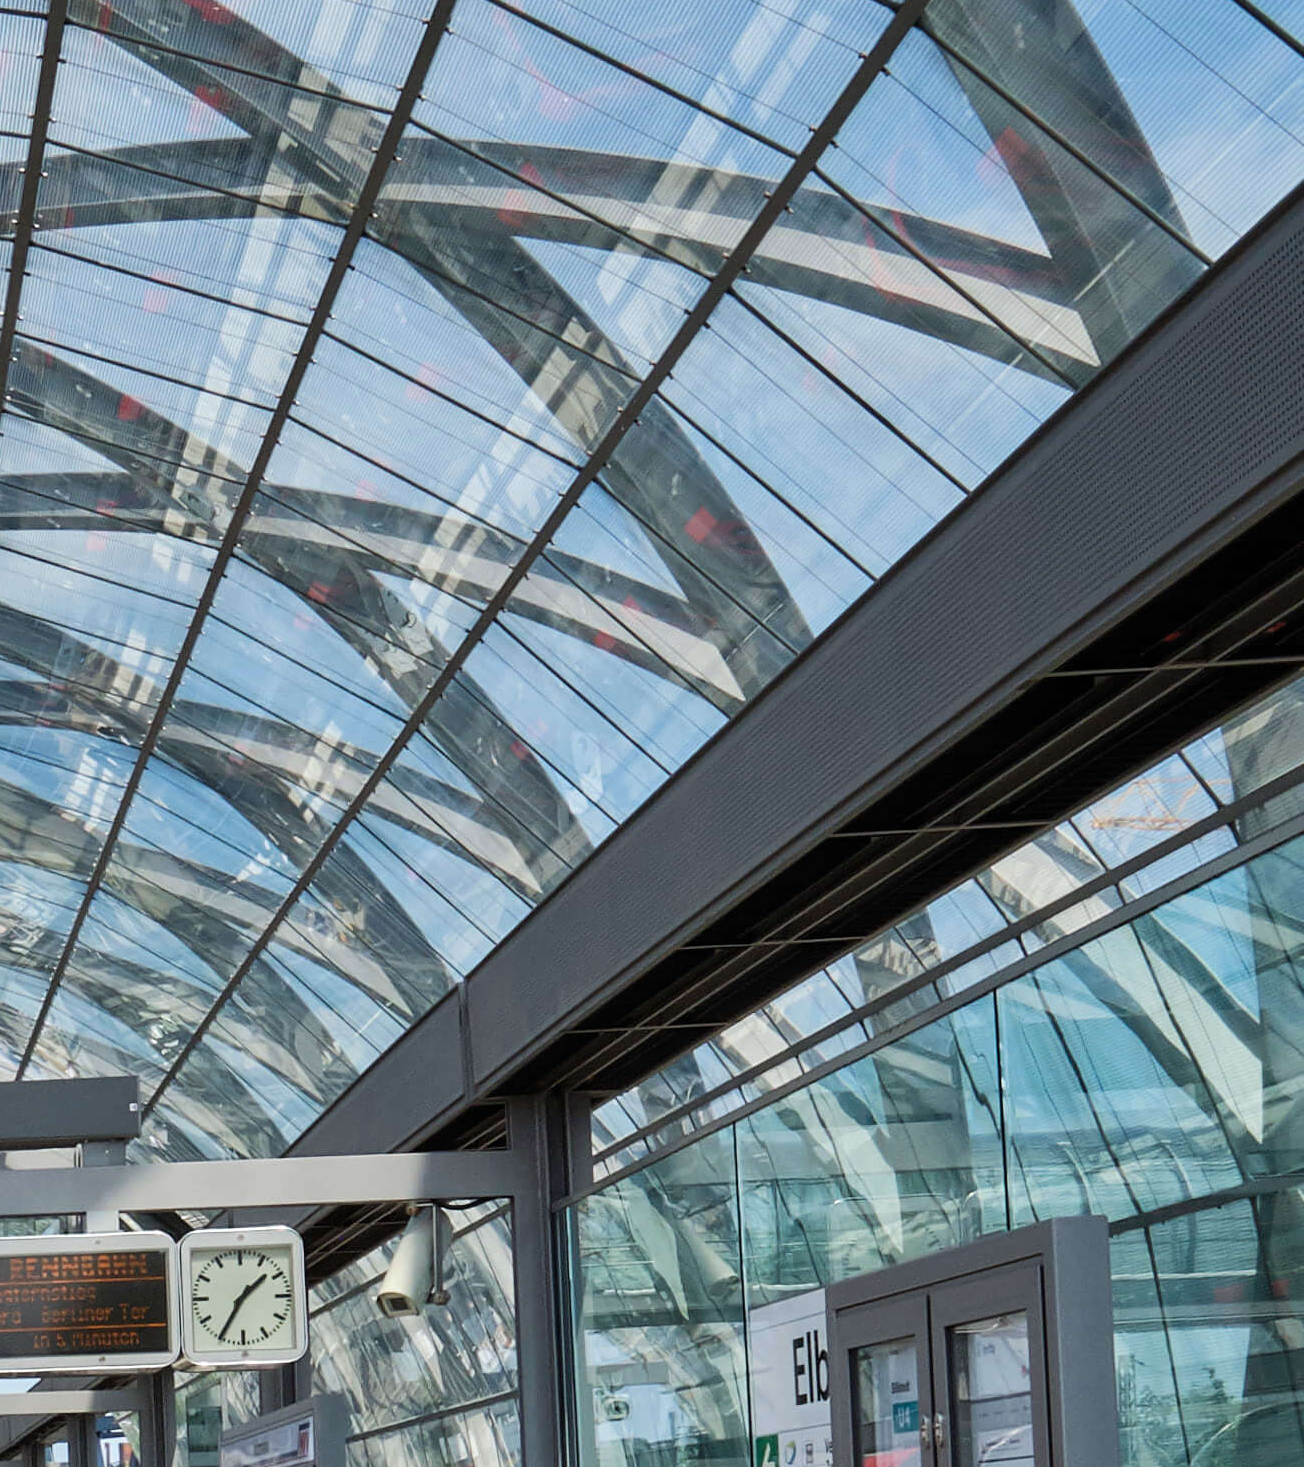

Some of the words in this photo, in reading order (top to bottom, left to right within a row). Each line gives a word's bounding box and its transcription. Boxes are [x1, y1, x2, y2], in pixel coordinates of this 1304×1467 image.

[41, 1305, 113, 1324] Berliner
[119, 1303, 150, 1320] Tor
[72, 1331, 140, 1347] Minuten
